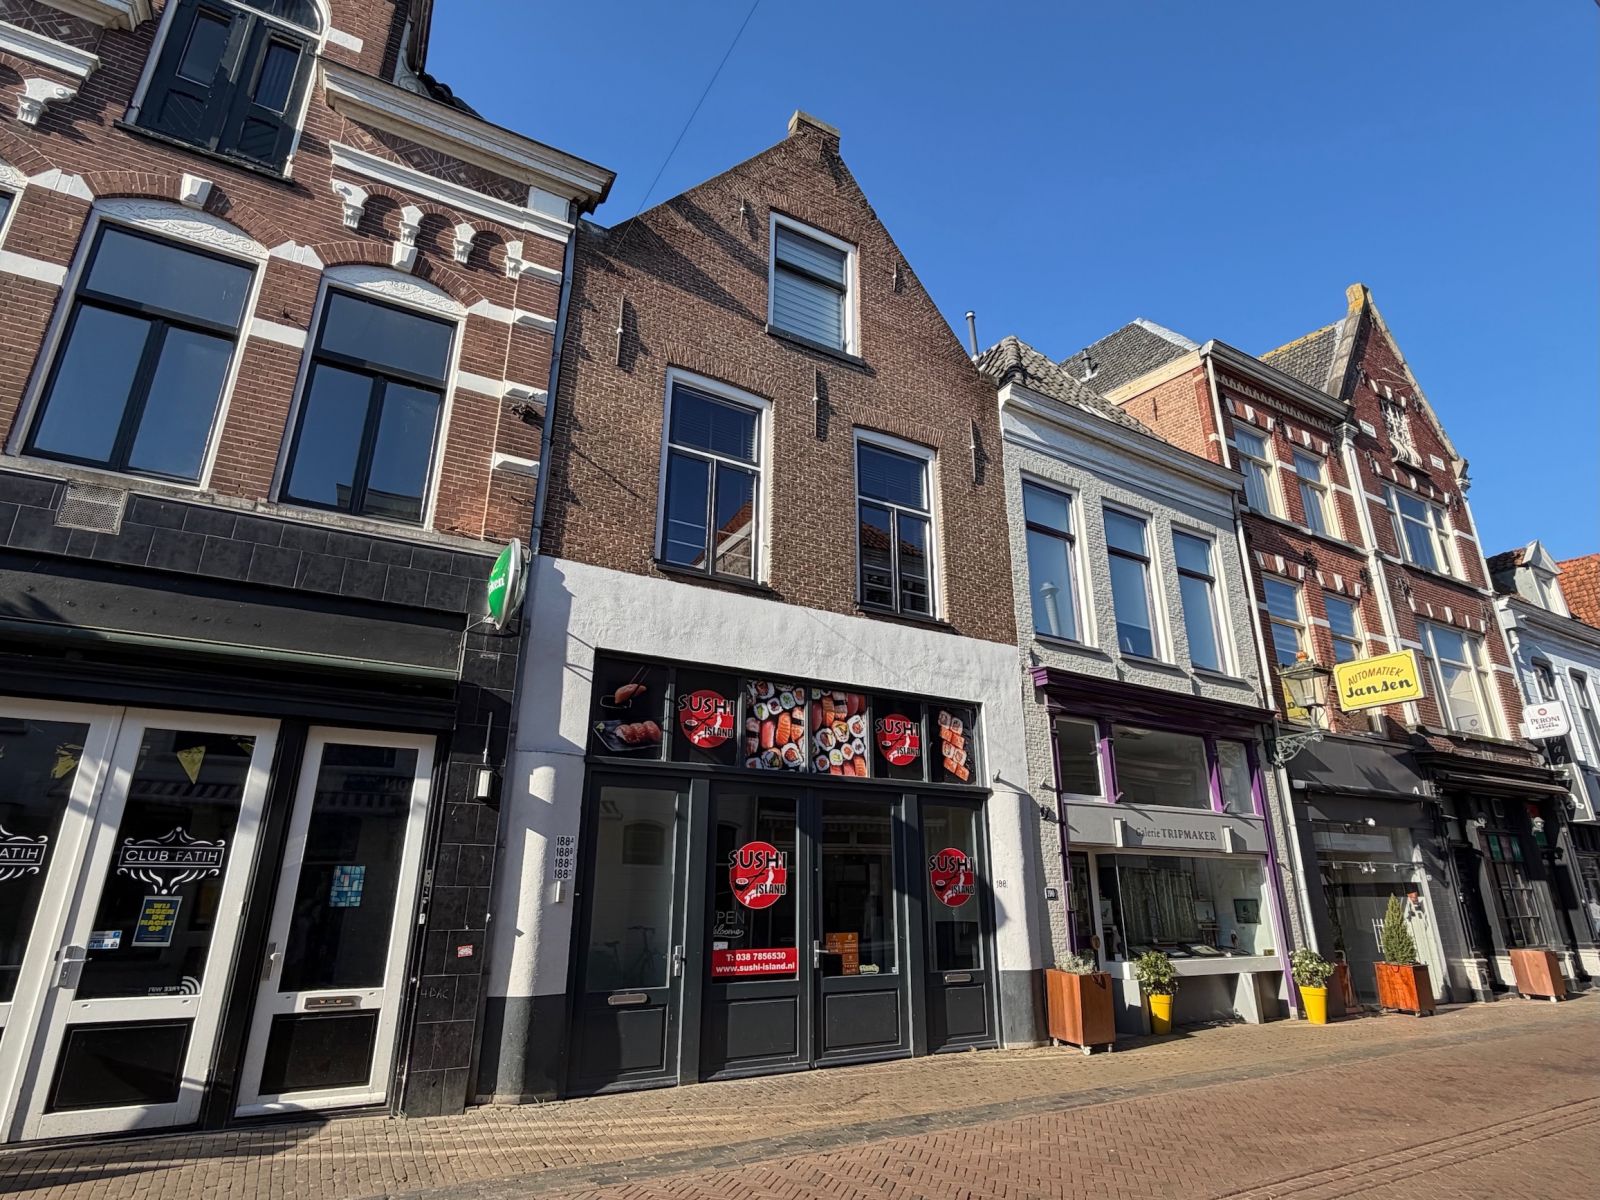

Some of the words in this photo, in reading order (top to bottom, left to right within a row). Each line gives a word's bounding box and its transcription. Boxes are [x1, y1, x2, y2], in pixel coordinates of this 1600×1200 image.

[1347, 666, 1404, 686] AUTOMATIEK
[1345, 679, 1413, 699] Jansen
[677, 694, 735, 717] SUSHI
[1530, 715, 1560, 725] PERONI
[704, 726, 734, 739] ISLAND
[875, 718, 919, 737] SUSHI
[896, 746, 920, 757] ISLAND
[1135, 827, 1161, 838] Galerie
[1160, 828, 1217, 841] TRIPMAKER
[0, 848, 39, 859] ATIH
[125, 850, 169, 862] CLUB
[175, 850, 219, 862] FATIH
[728, 850, 788, 870] SUSHI
[928, 854, 974, 874] SUSHI
[756, 883, 787, 895] ISLAND
[951, 884, 976, 896] ISLAND
[715, 910, 745, 924] PEN
[725, 954, 734, 962] T:
[736, 953, 751, 961] 038
[753, 951, 786, 960] 7856530
[715, 962, 795, 973] www.sushi-island.nl
